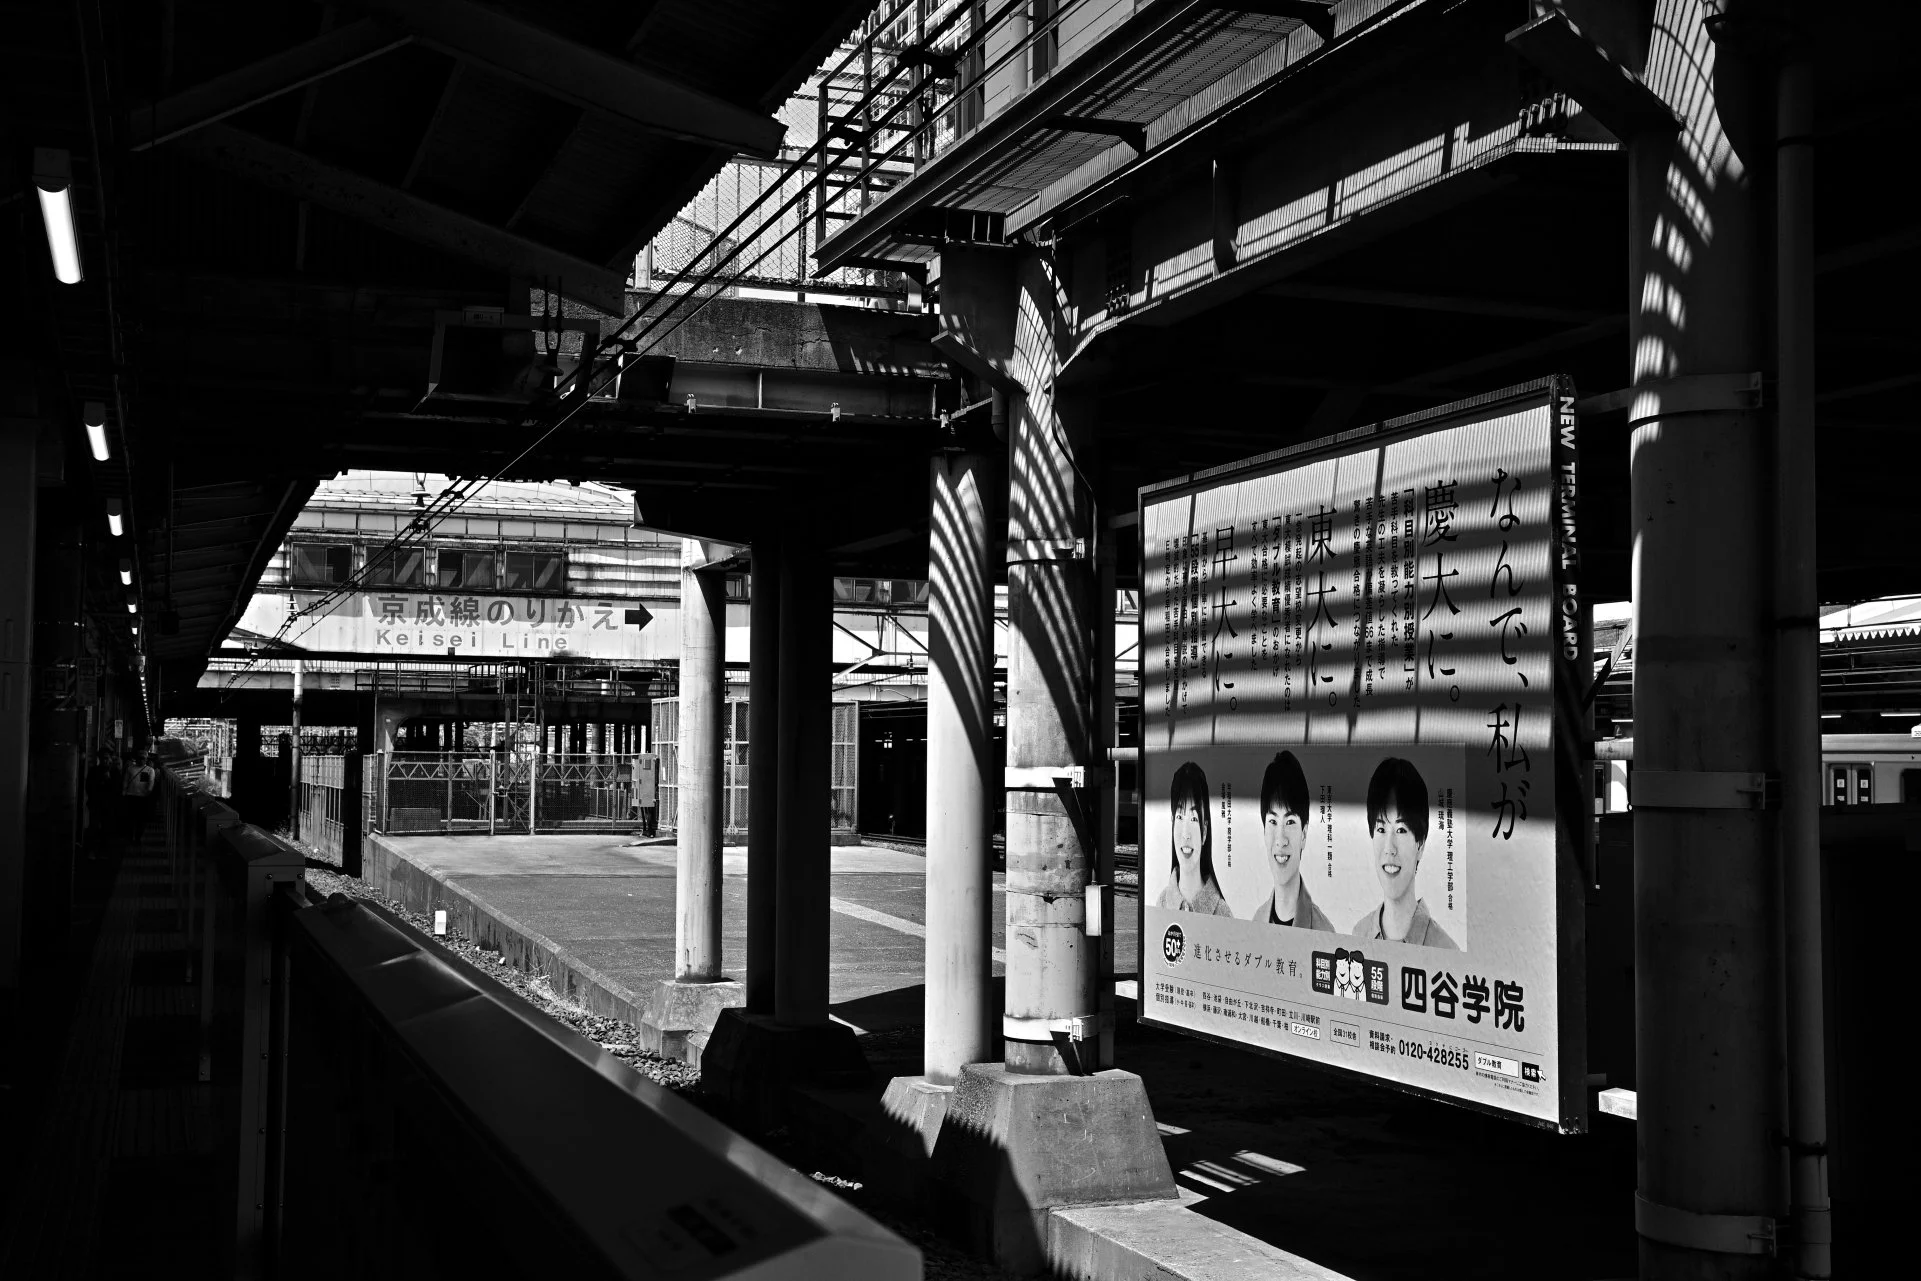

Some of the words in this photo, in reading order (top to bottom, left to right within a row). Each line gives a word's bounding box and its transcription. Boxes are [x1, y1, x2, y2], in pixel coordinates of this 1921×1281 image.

[1559, 395, 1575, 449] NEW
[1559, 461, 1577, 570] TERMINAL
[377, 594, 619, 632] 京成線のりかえ
[1211, 524, 1238, 711] 早大に。
[1306, 504, 1338, 708] 東大に。
[1403, 487, 1415, 691] 「科目別能力別授業」が
[1421, 479, 1461, 703] 慶大に。
[1561, 583, 1578, 662] BOARD
[376, 631, 477, 649] Keisei
[502, 632, 569, 651] Line
[1487, 467, 1531, 841] なんで、私が
[1193, 943, 1303, 979] 進化させるダブル教育。
[1371, 966, 1383, 981] 55
[1401, 966, 1525, 1033] 四谷学院
[1398, 1039, 1470, 1071] 0120-428255
